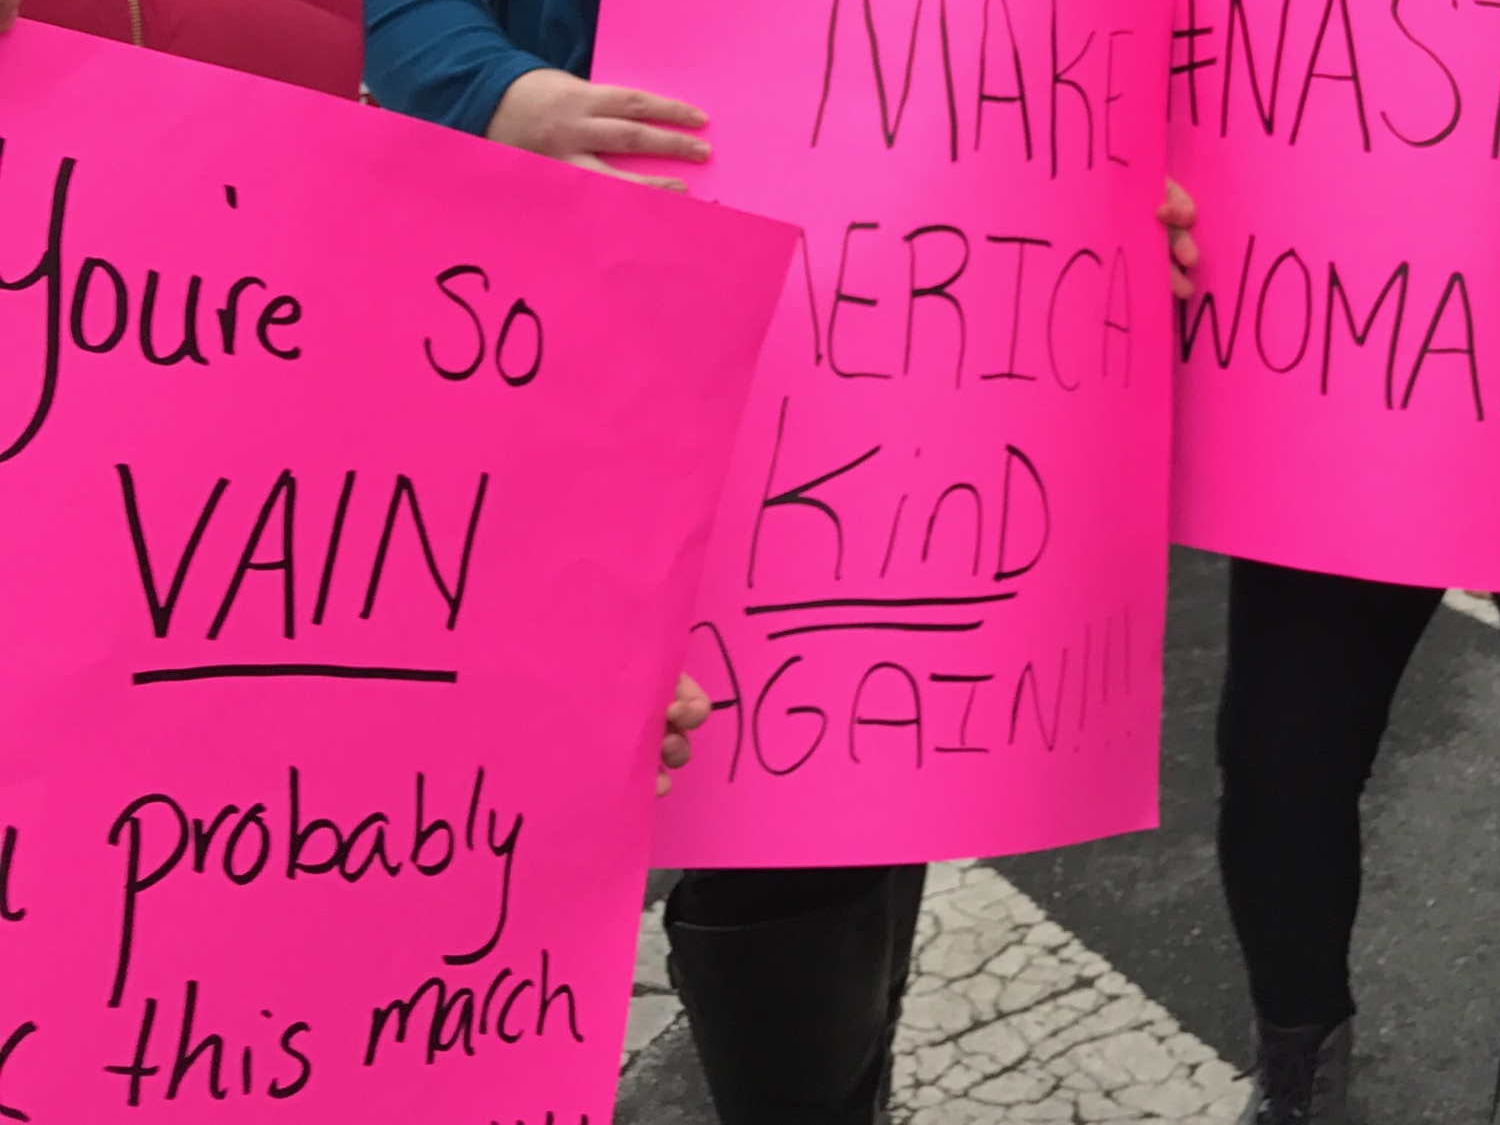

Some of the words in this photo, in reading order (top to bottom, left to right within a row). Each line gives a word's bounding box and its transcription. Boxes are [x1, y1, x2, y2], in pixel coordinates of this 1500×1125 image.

[116, 463, 489, 640] VAIN
[107, 765, 523, 1008] probably
[103, 979, 312, 1106] this
[364, 948, 584, 1066] march
